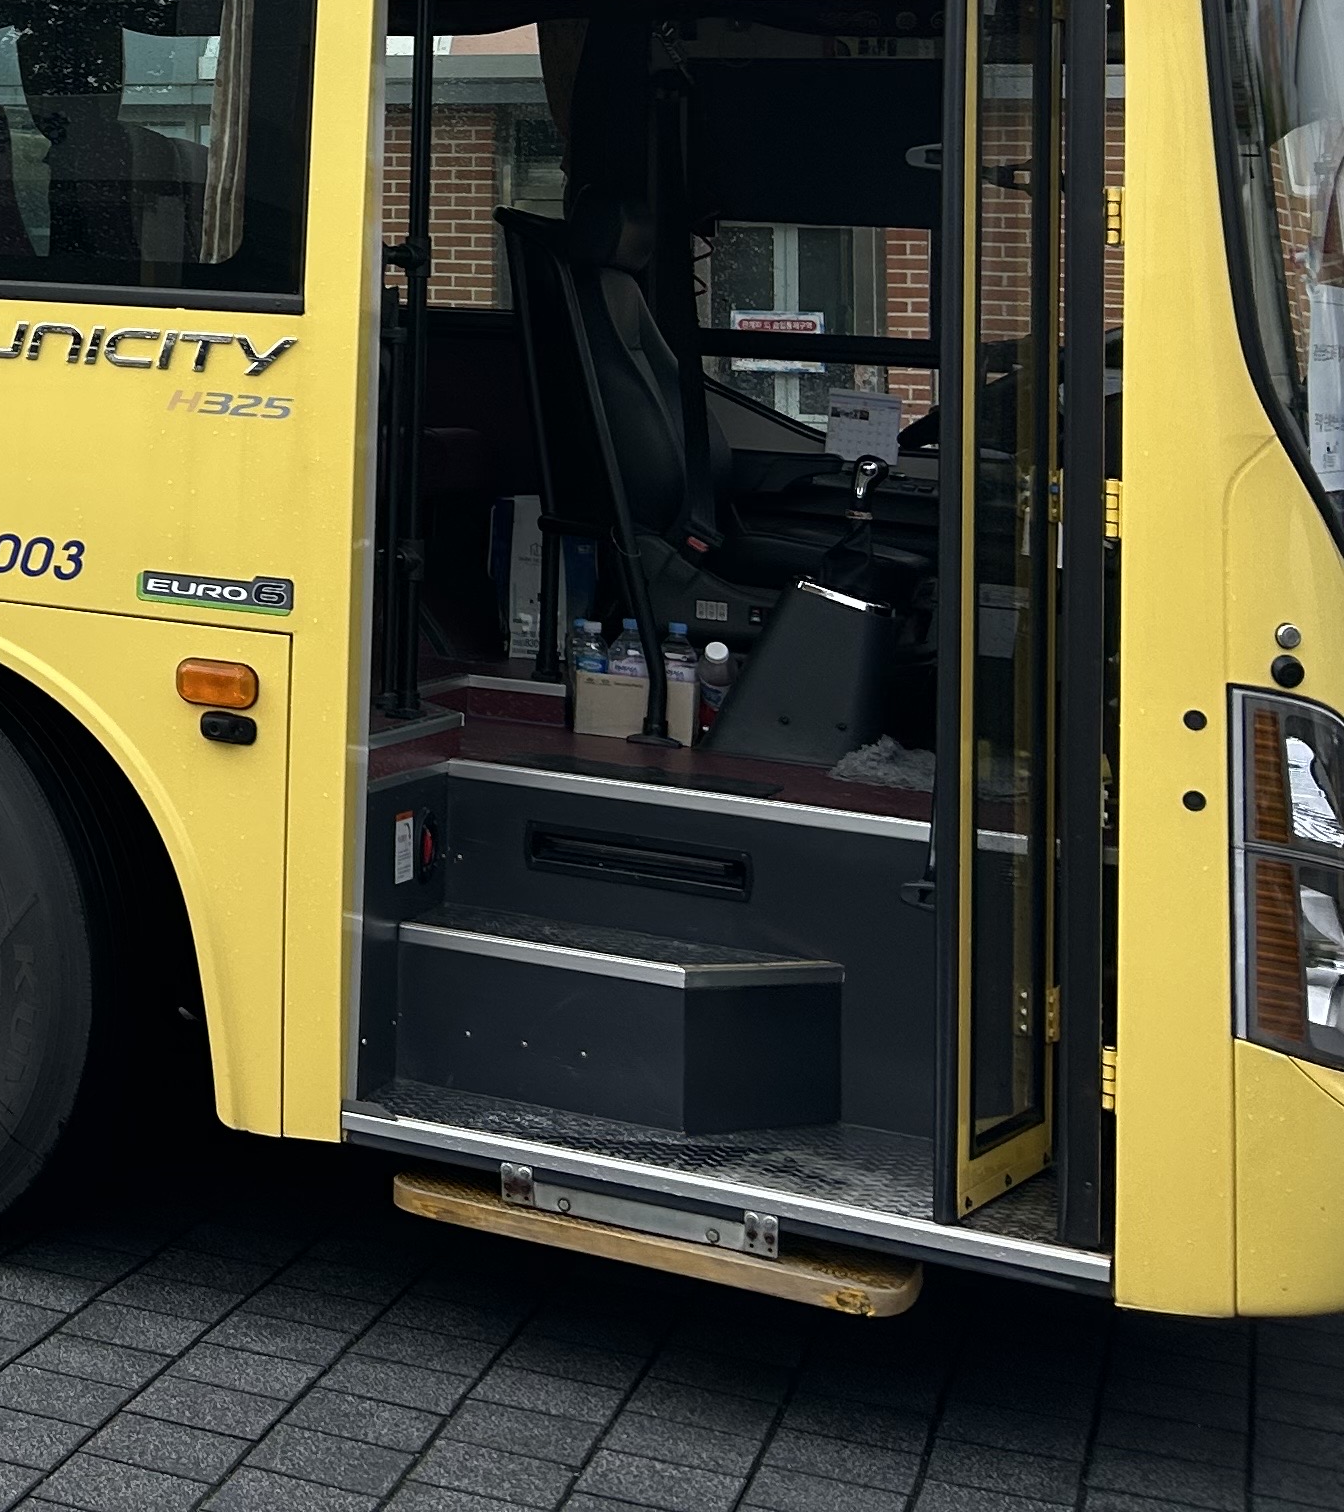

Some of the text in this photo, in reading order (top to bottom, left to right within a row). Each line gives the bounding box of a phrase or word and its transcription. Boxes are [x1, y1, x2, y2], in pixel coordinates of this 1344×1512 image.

[166, 390, 294, 419] H325
[146, 577, 288, 607] EURO 6
